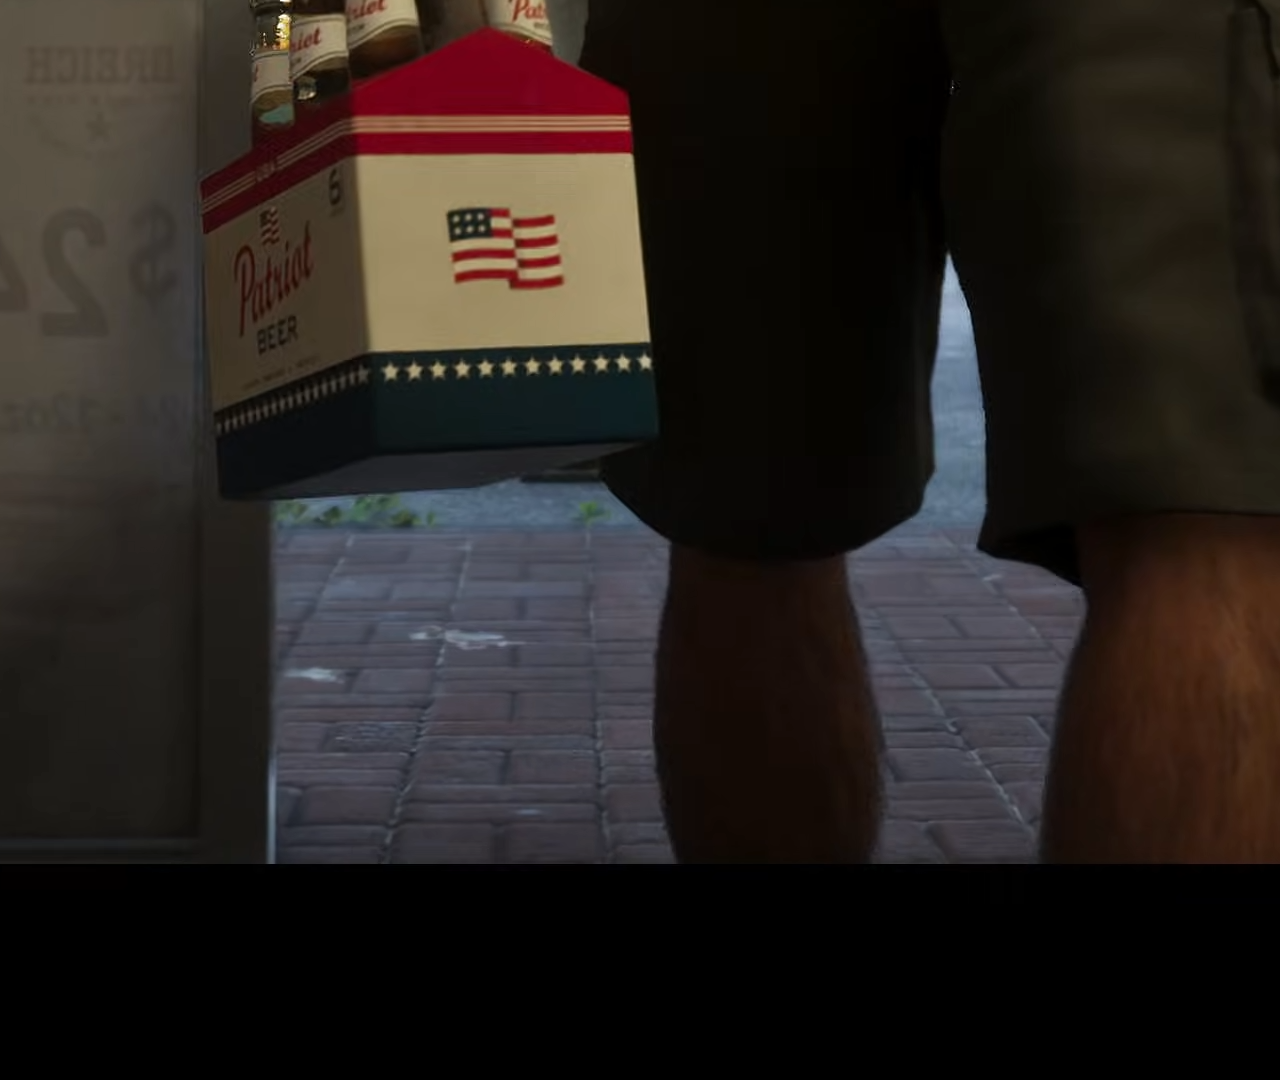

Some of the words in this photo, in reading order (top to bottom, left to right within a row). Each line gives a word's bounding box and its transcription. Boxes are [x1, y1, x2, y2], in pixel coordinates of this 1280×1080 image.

[328, 169, 342, 206] 6
[234, 220, 313, 339] Patriot
[257, 315, 298, 356] BEER
